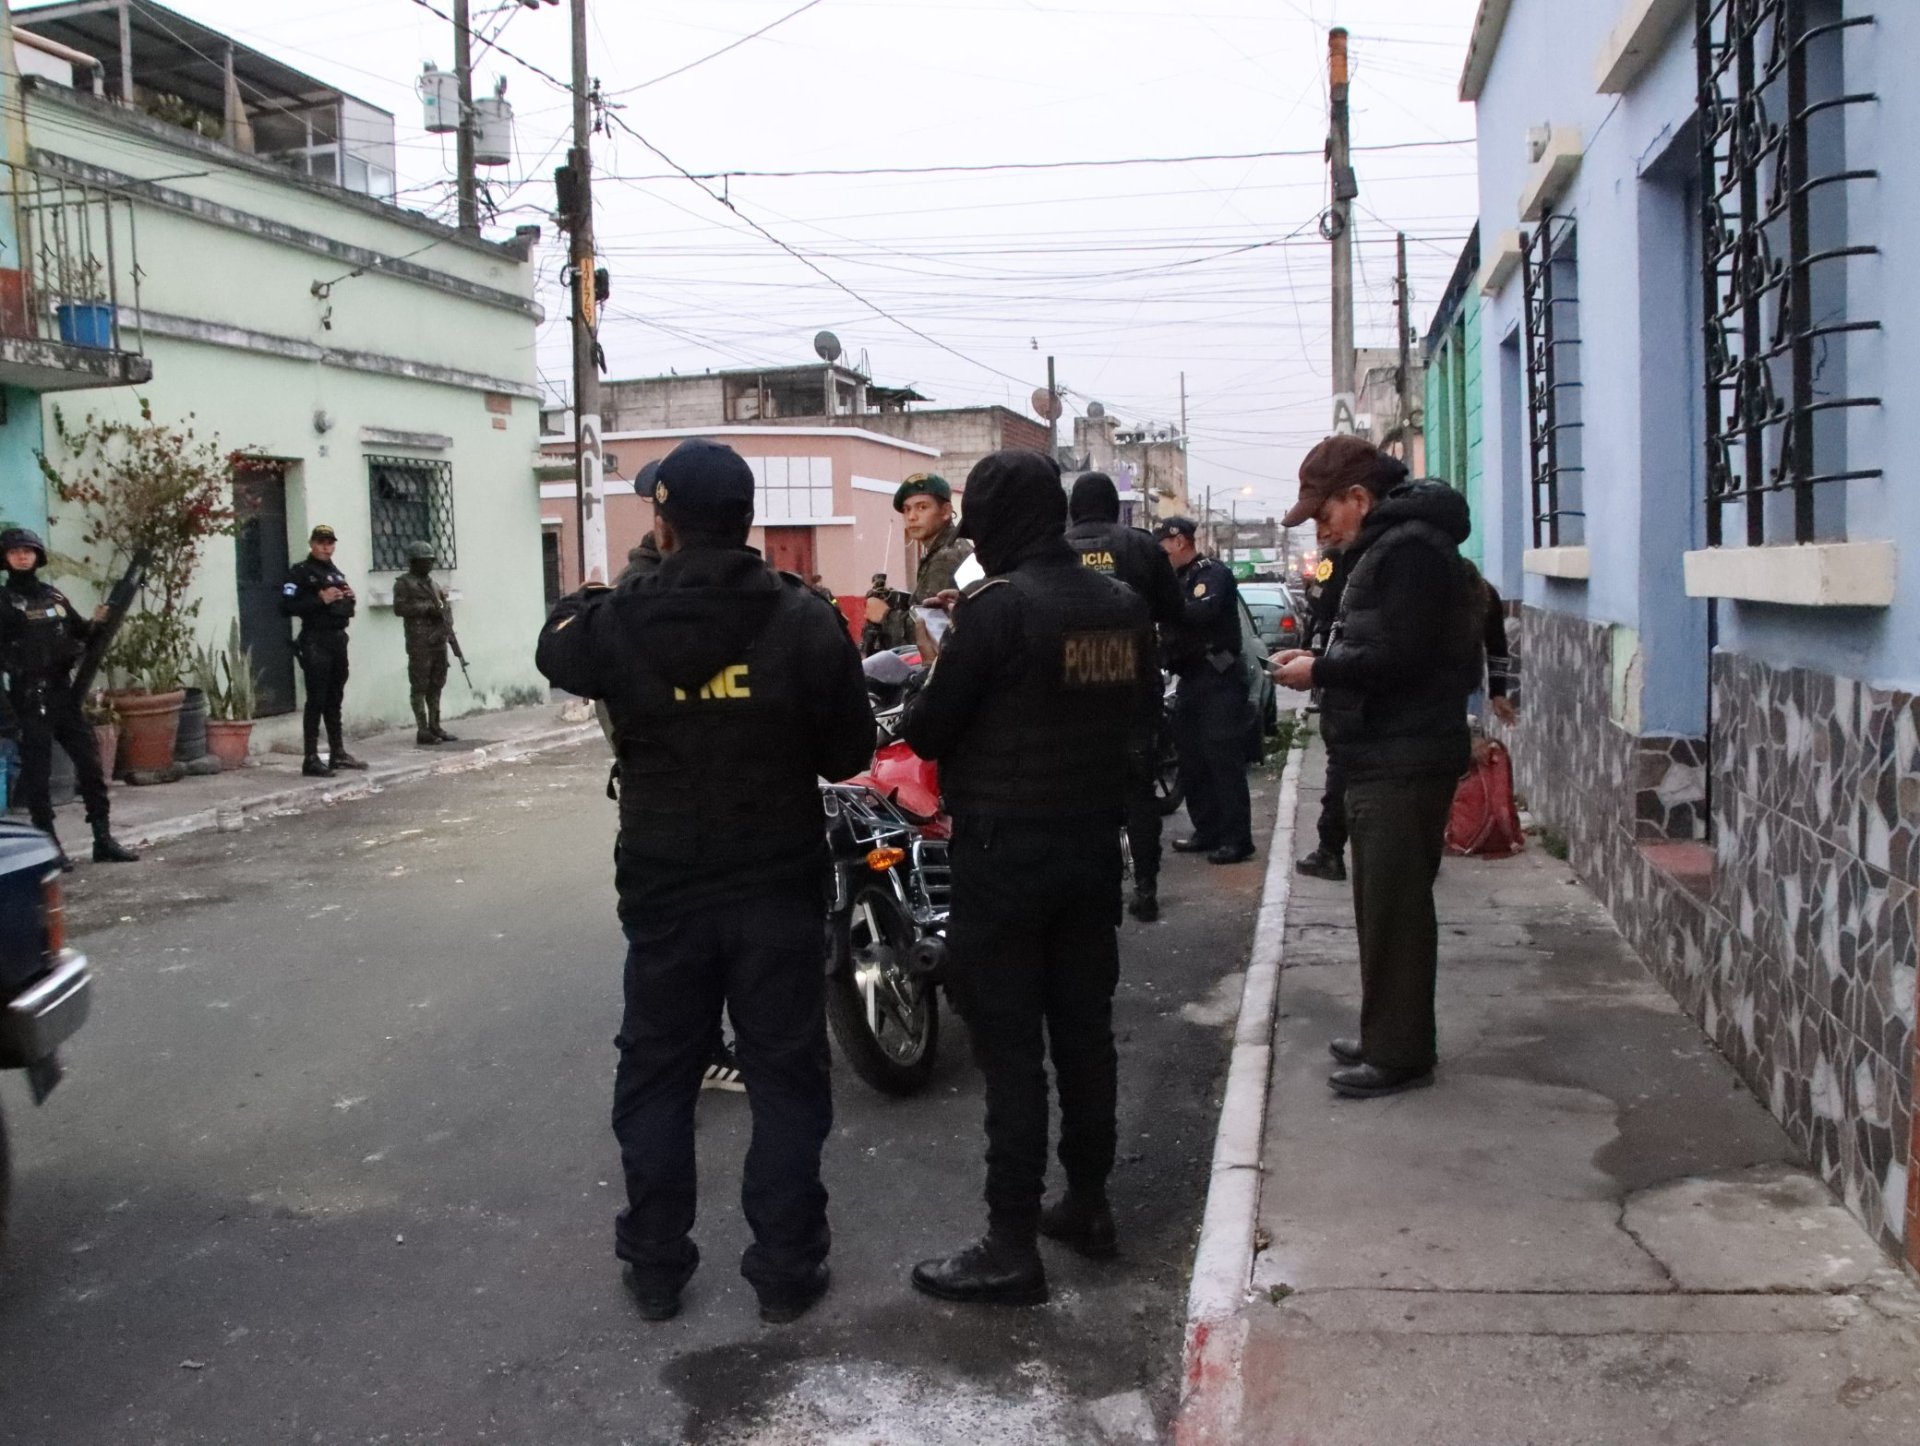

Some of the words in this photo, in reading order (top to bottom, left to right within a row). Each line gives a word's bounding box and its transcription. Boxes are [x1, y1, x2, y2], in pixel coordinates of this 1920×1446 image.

[1333, 399, 1355, 434] A
[1082, 552, 1114, 565] ICIA
[1064, 638, 1136, 683] POLICIA
[673, 664, 751, 700] NC
